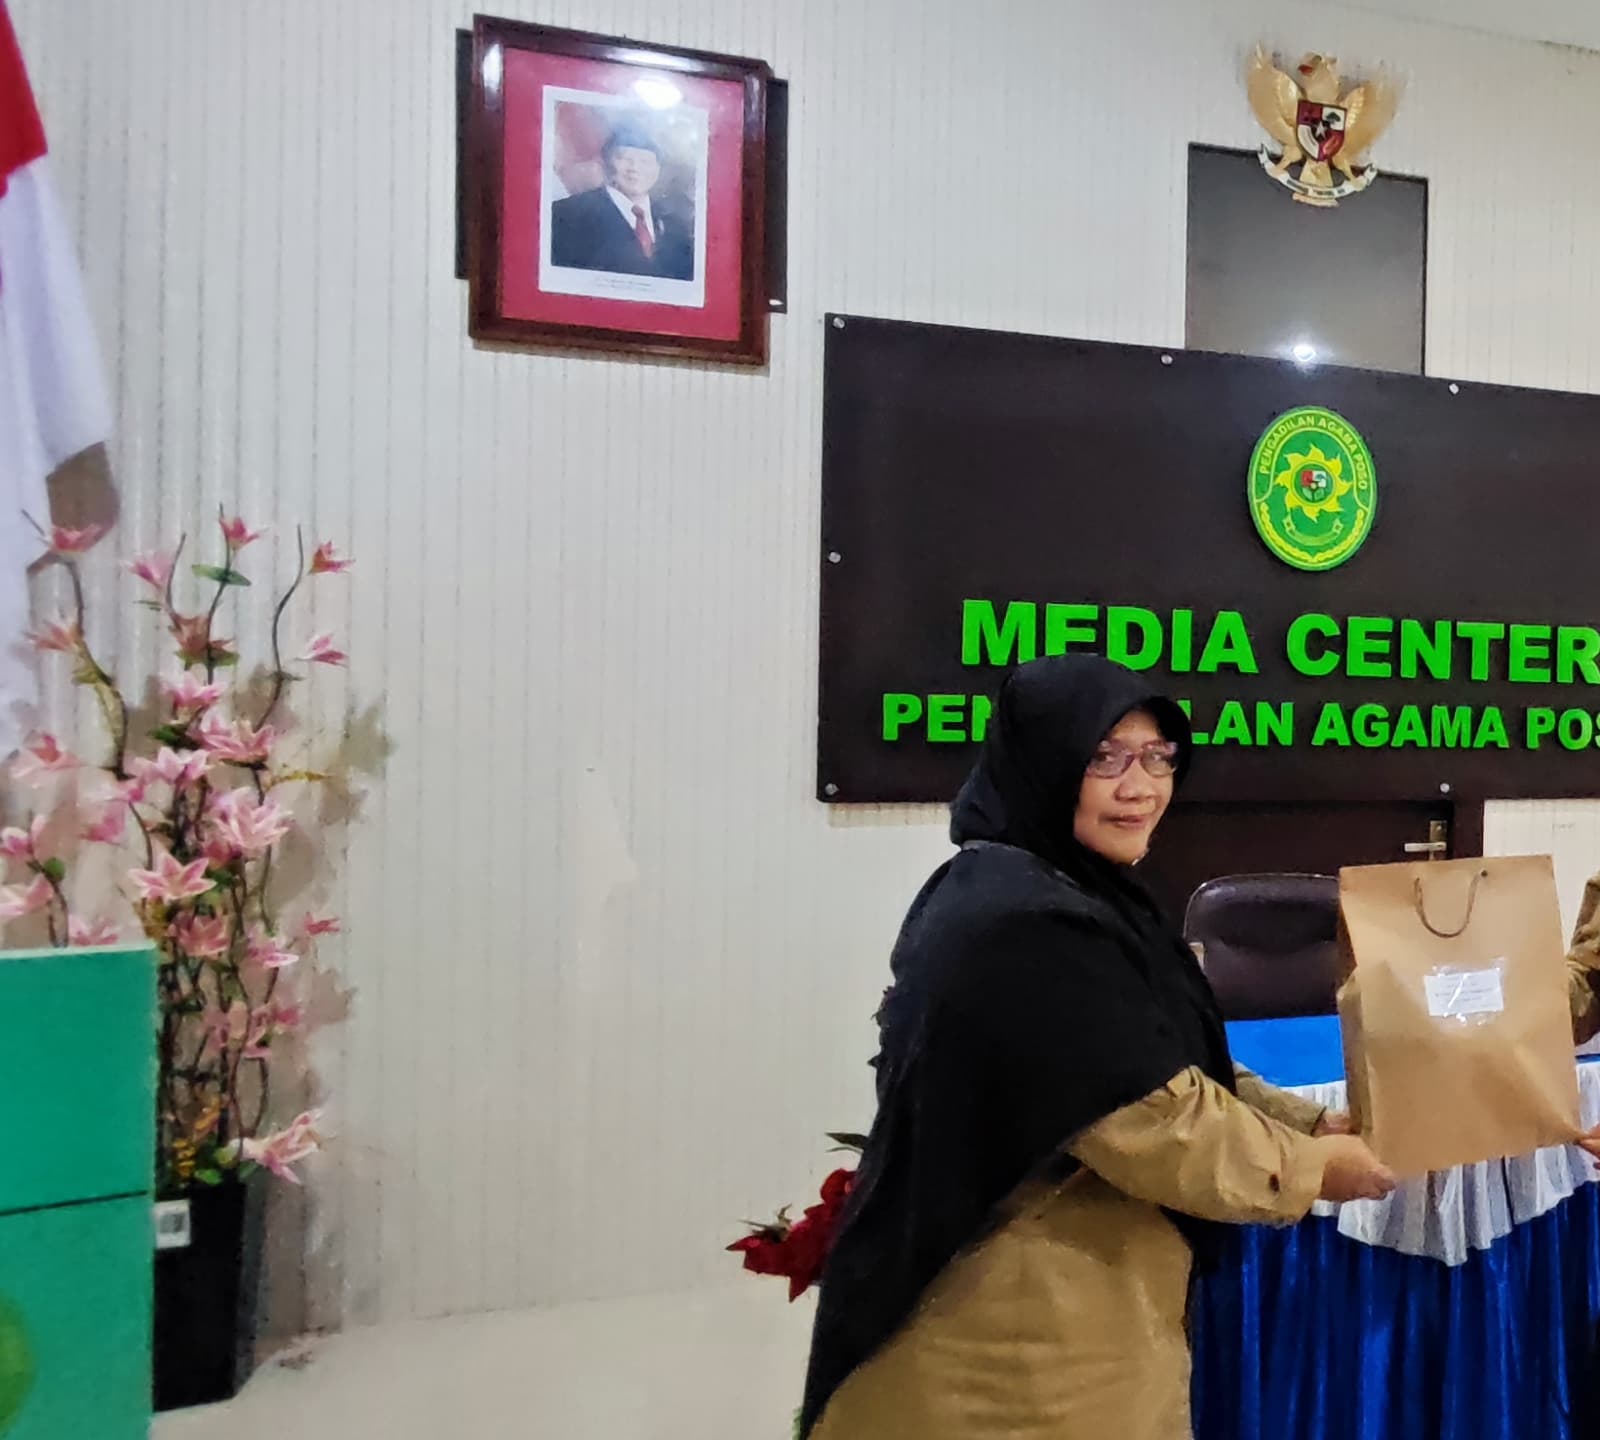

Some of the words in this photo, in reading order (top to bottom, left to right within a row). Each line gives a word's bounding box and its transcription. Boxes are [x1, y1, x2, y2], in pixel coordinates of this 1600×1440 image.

[1260, 416, 1315, 474] PENGADILAN
[1319, 418, 1358, 453] AGAMA
[1354, 454, 1368, 490] POSO
[961, 599, 1258, 673] MEDIA
[882, 693, 1293, 746] PENLAN
[1312, 702, 1509, 749] AGAMA
